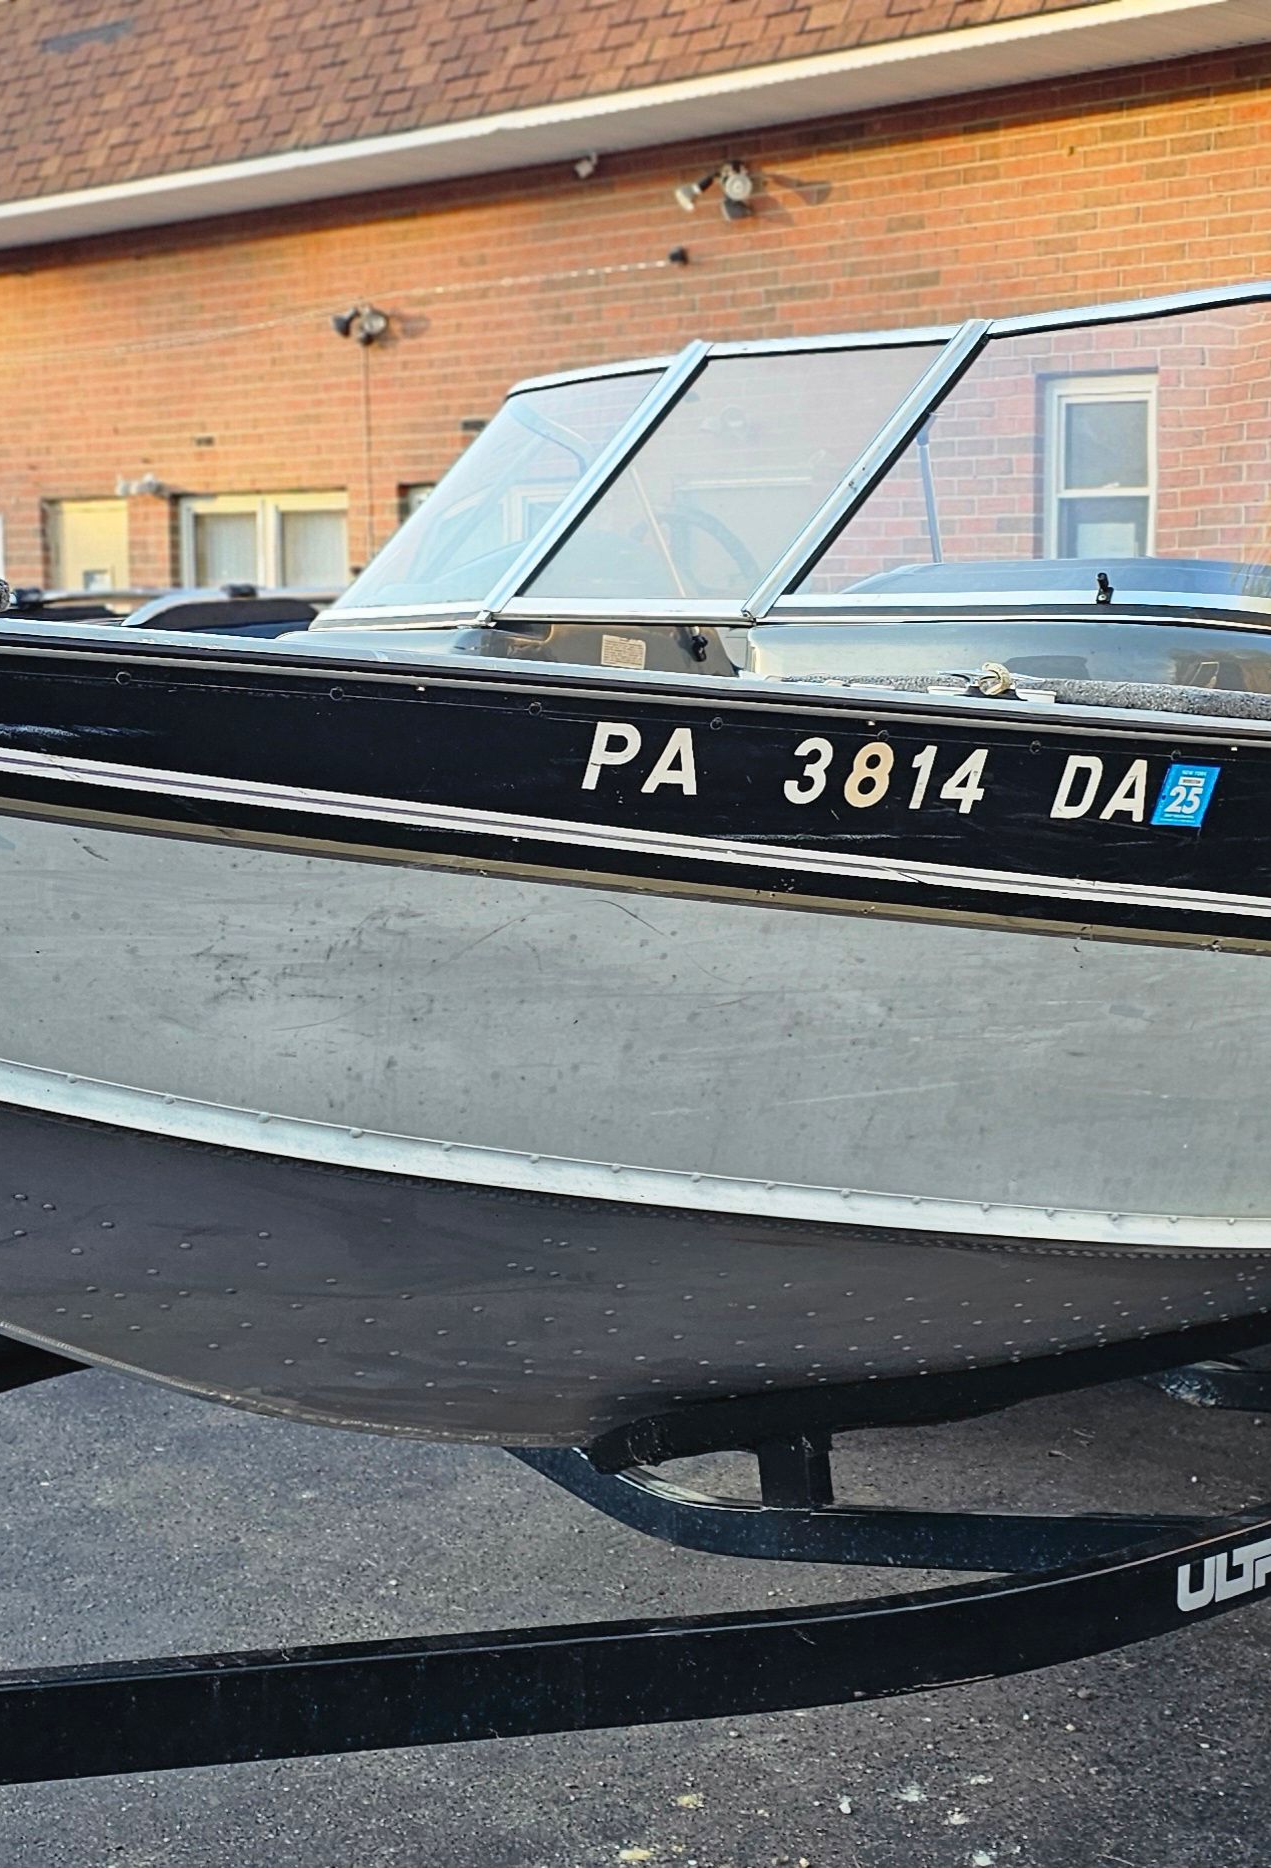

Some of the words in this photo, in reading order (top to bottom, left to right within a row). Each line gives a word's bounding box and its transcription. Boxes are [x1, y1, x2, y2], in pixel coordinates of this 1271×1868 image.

[581, 721, 697, 795] PA
[783, 737, 988, 814] 3814
[1050, 755, 1148, 823] DA
[1164, 785, 1204, 814] 25
